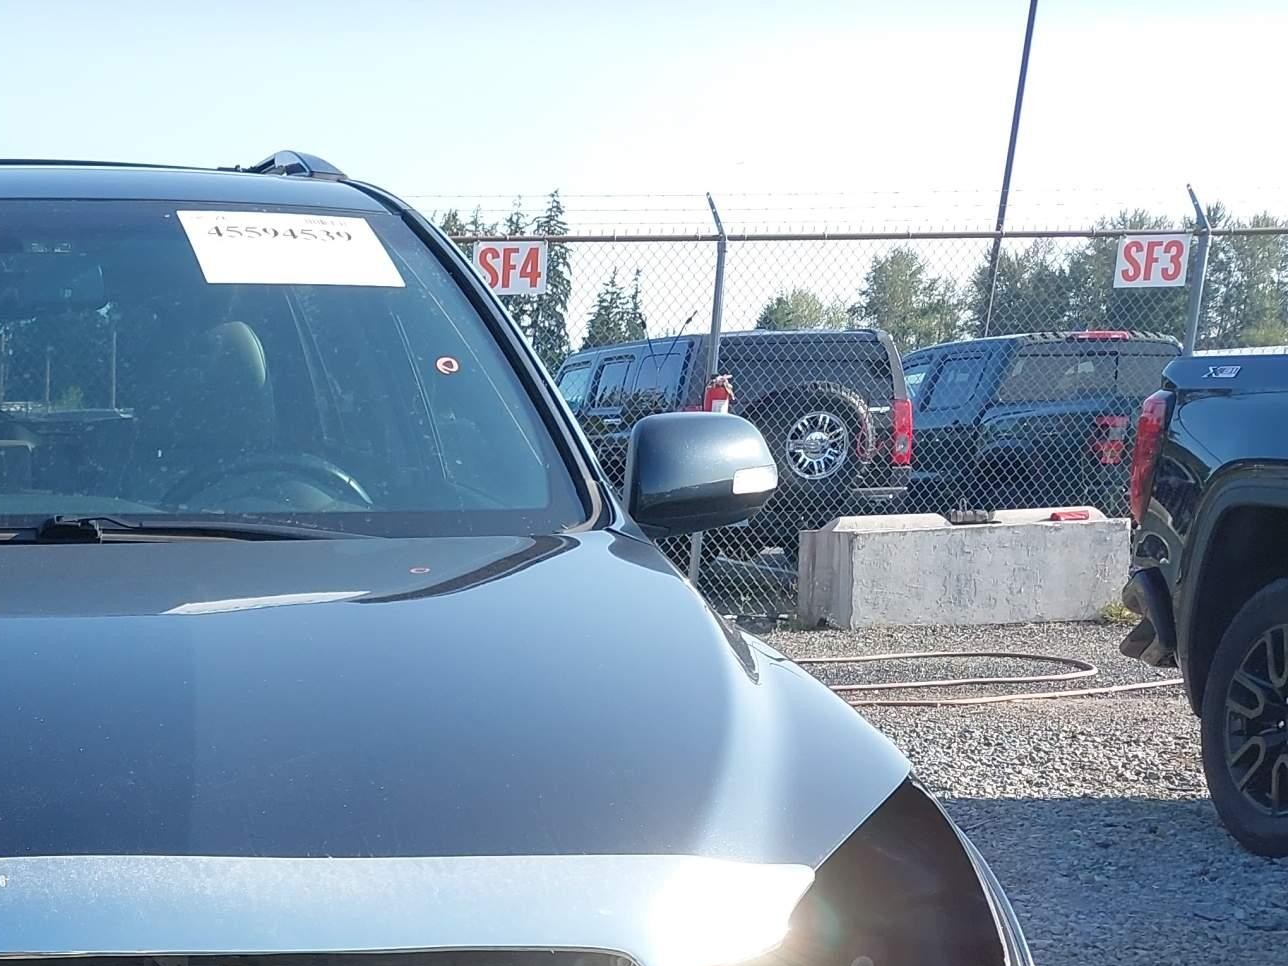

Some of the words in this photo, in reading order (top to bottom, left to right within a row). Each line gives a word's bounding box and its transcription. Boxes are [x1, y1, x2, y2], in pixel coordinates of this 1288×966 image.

[208, 225, 352, 241] 45594539
[479, 247, 542, 289] SF4
[1121, 239, 1185, 282] SF3
